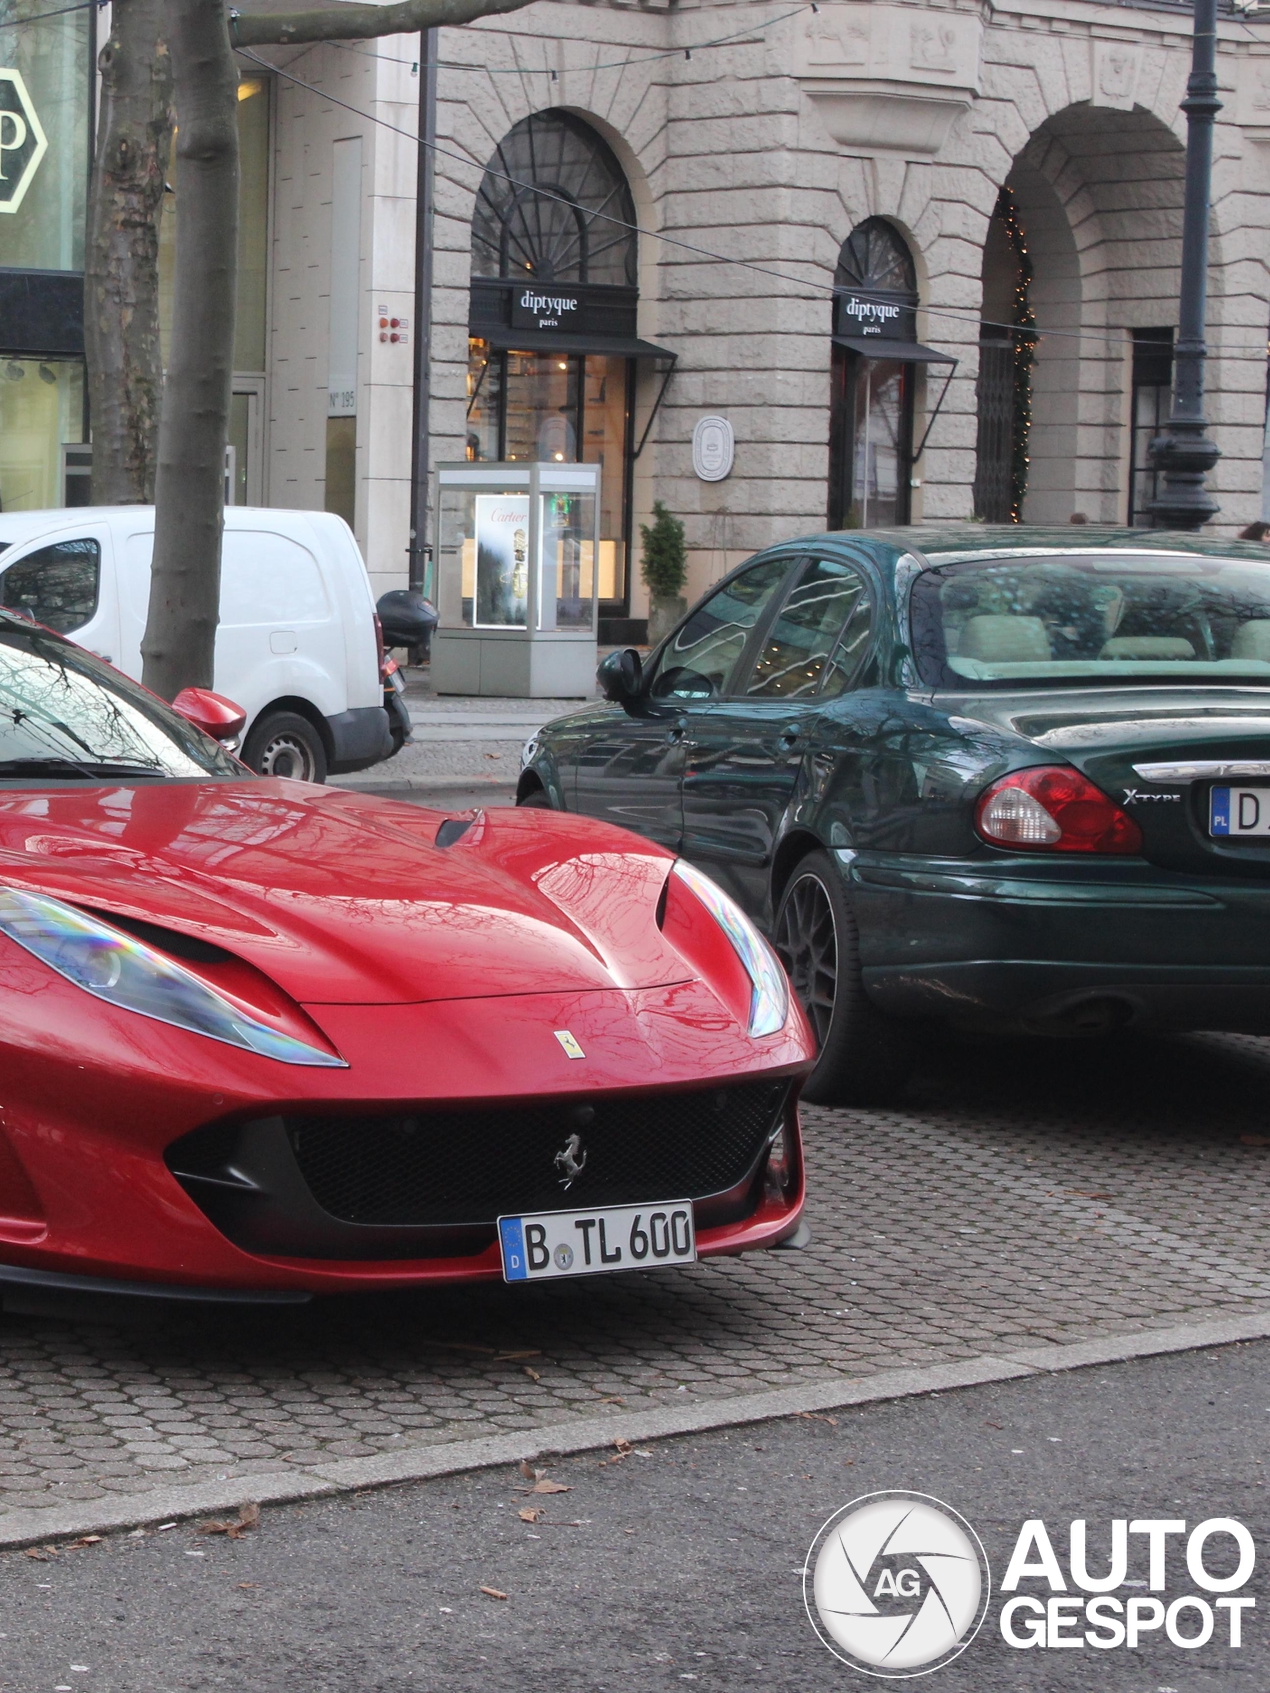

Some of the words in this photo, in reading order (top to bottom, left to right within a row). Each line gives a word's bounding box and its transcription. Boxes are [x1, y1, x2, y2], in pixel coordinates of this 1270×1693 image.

[520, 290, 578, 316] diptyque
[846, 297, 900, 323] diptyque
[539, 318, 558, 329] paris
[863, 325, 881, 335] paris
[341, 391, 355, 408] 195
[490, 507, 528, 523] Cartier
[1238, 792, 1270, 830] D
[1214, 815, 1228, 827] PL
[524, 1223, 550, 1271] B
[510, 1254, 520, 1269] D
